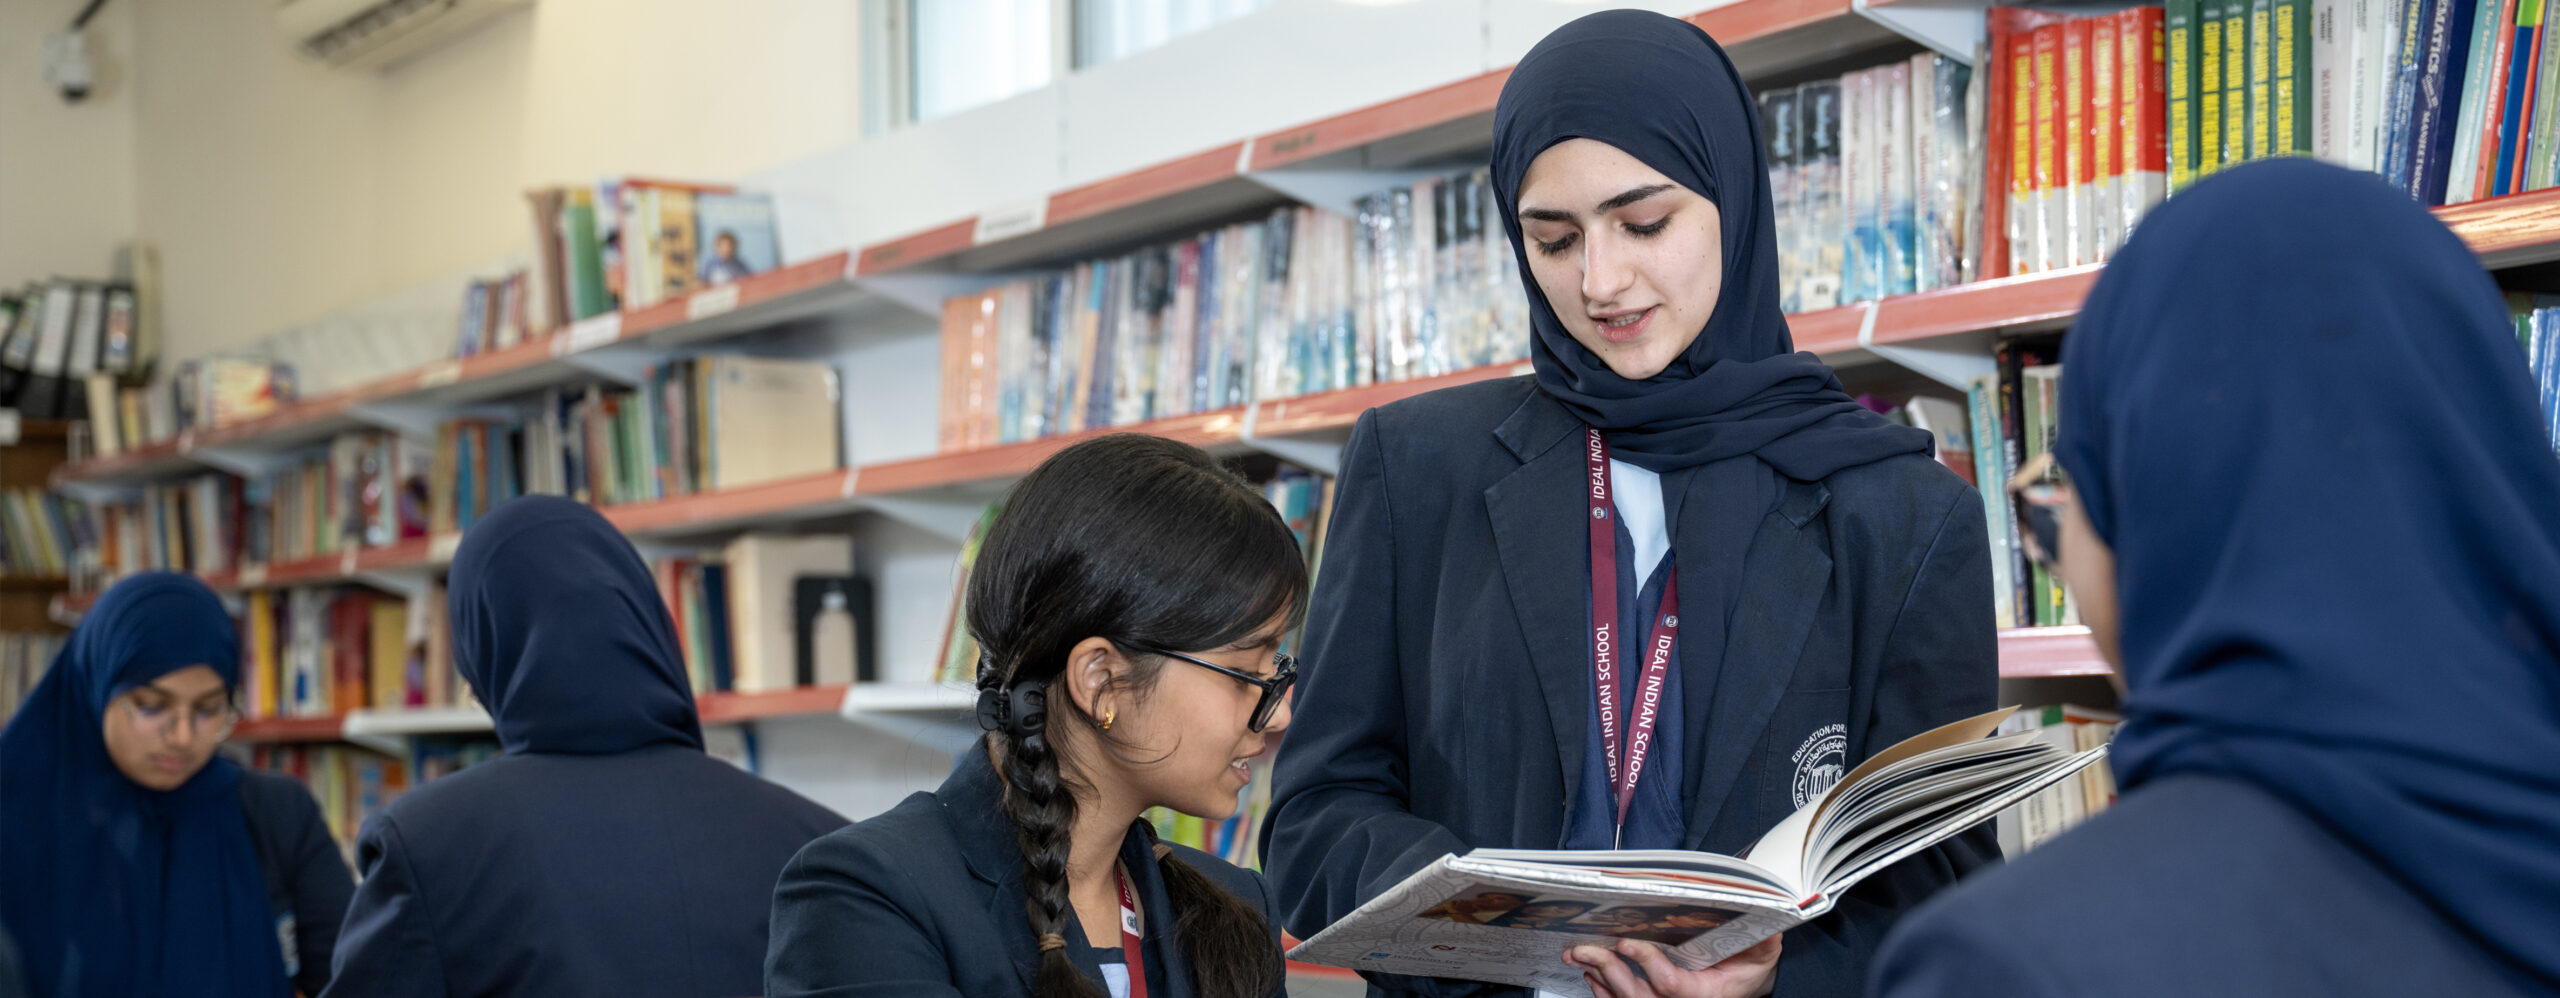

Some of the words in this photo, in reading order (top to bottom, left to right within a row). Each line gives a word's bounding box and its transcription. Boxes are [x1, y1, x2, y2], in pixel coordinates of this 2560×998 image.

[2474, 30, 2491, 84] Secondary
[2321, 68, 2332, 158] MATHEMATICS
[2485, 42, 2505, 130] MATHEMATICS
[1592, 465, 1605, 499] IDEAL
[1597, 623, 1610, 680] SCHOOL
[1651, 634, 1672, 672] IDEAL
[1600, 684, 1614, 738] INDIAN
[1638, 676, 1662, 728] INDIAN
[1606, 740, 1617, 782] IDEAL
[1626, 731, 1648, 790] SCHOOL
[1792, 725, 1830, 764] EDUCATION
[1831, 724, 1846, 734] FOR
